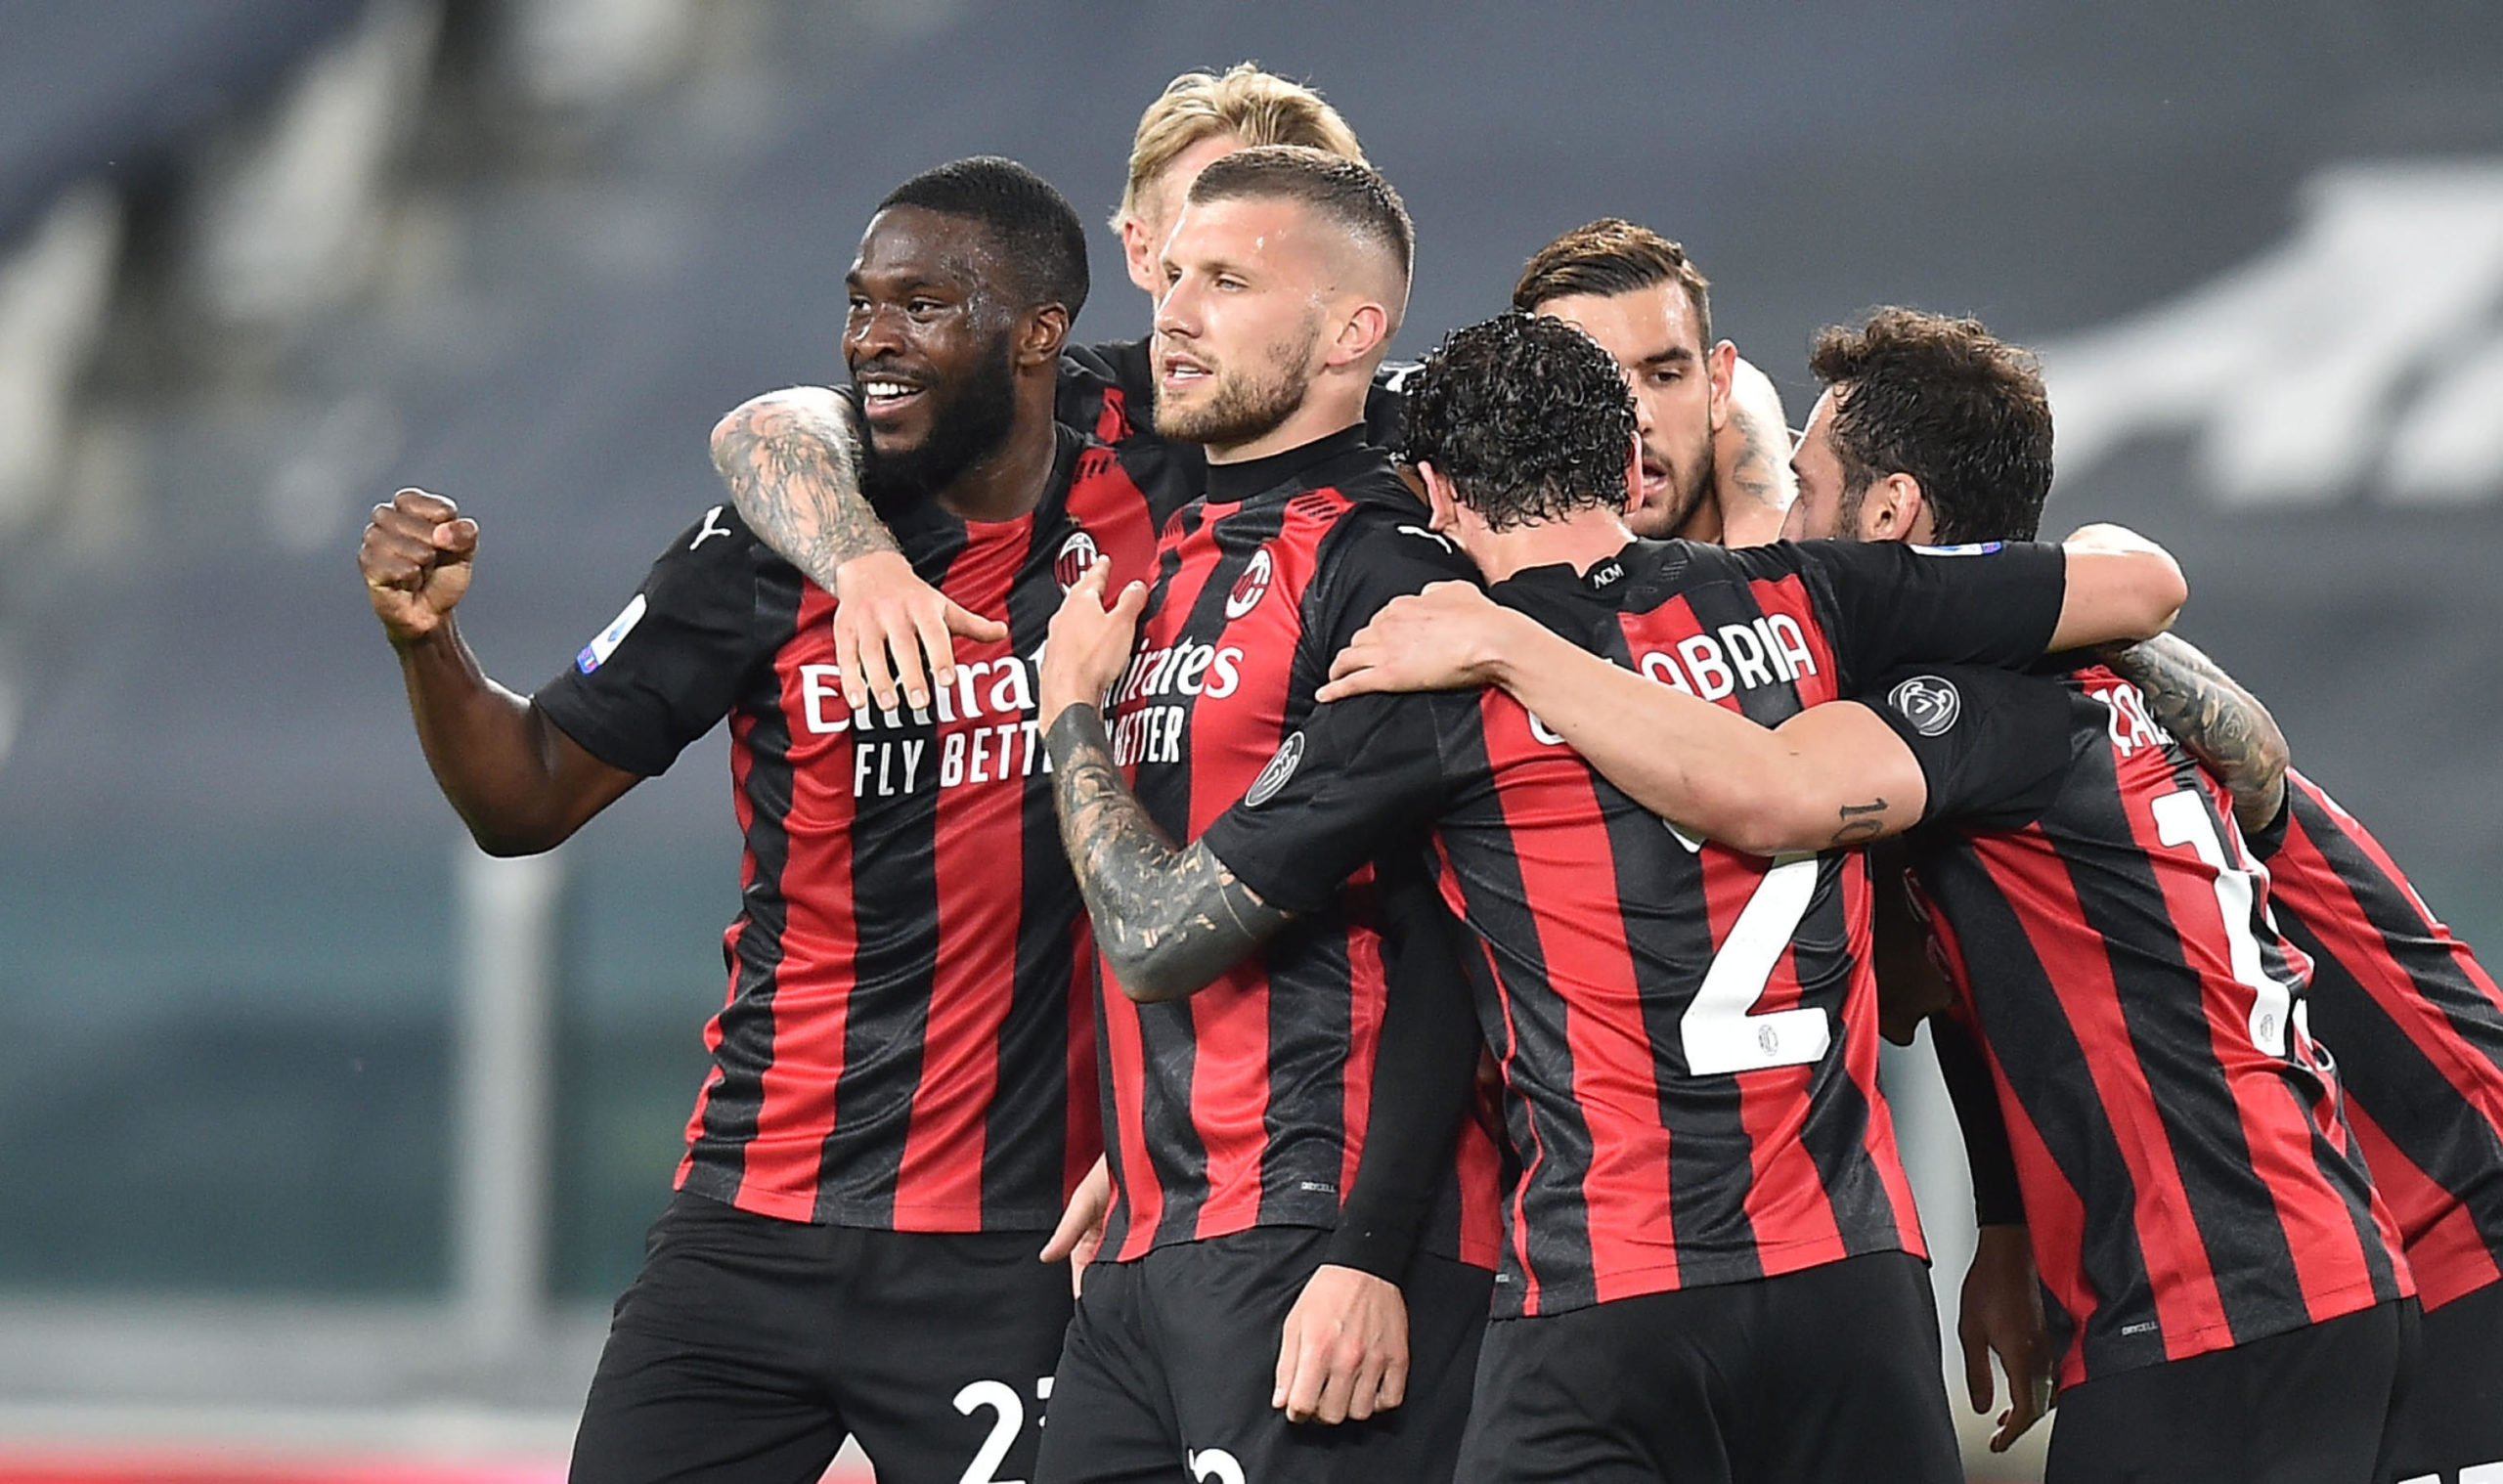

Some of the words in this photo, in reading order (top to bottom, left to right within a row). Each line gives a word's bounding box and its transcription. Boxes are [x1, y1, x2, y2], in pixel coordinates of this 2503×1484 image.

[854, 739, 925, 798] FLY
[1665, 826, 1832, 1076] 2
[952, 1376, 1055, 1484] 2
